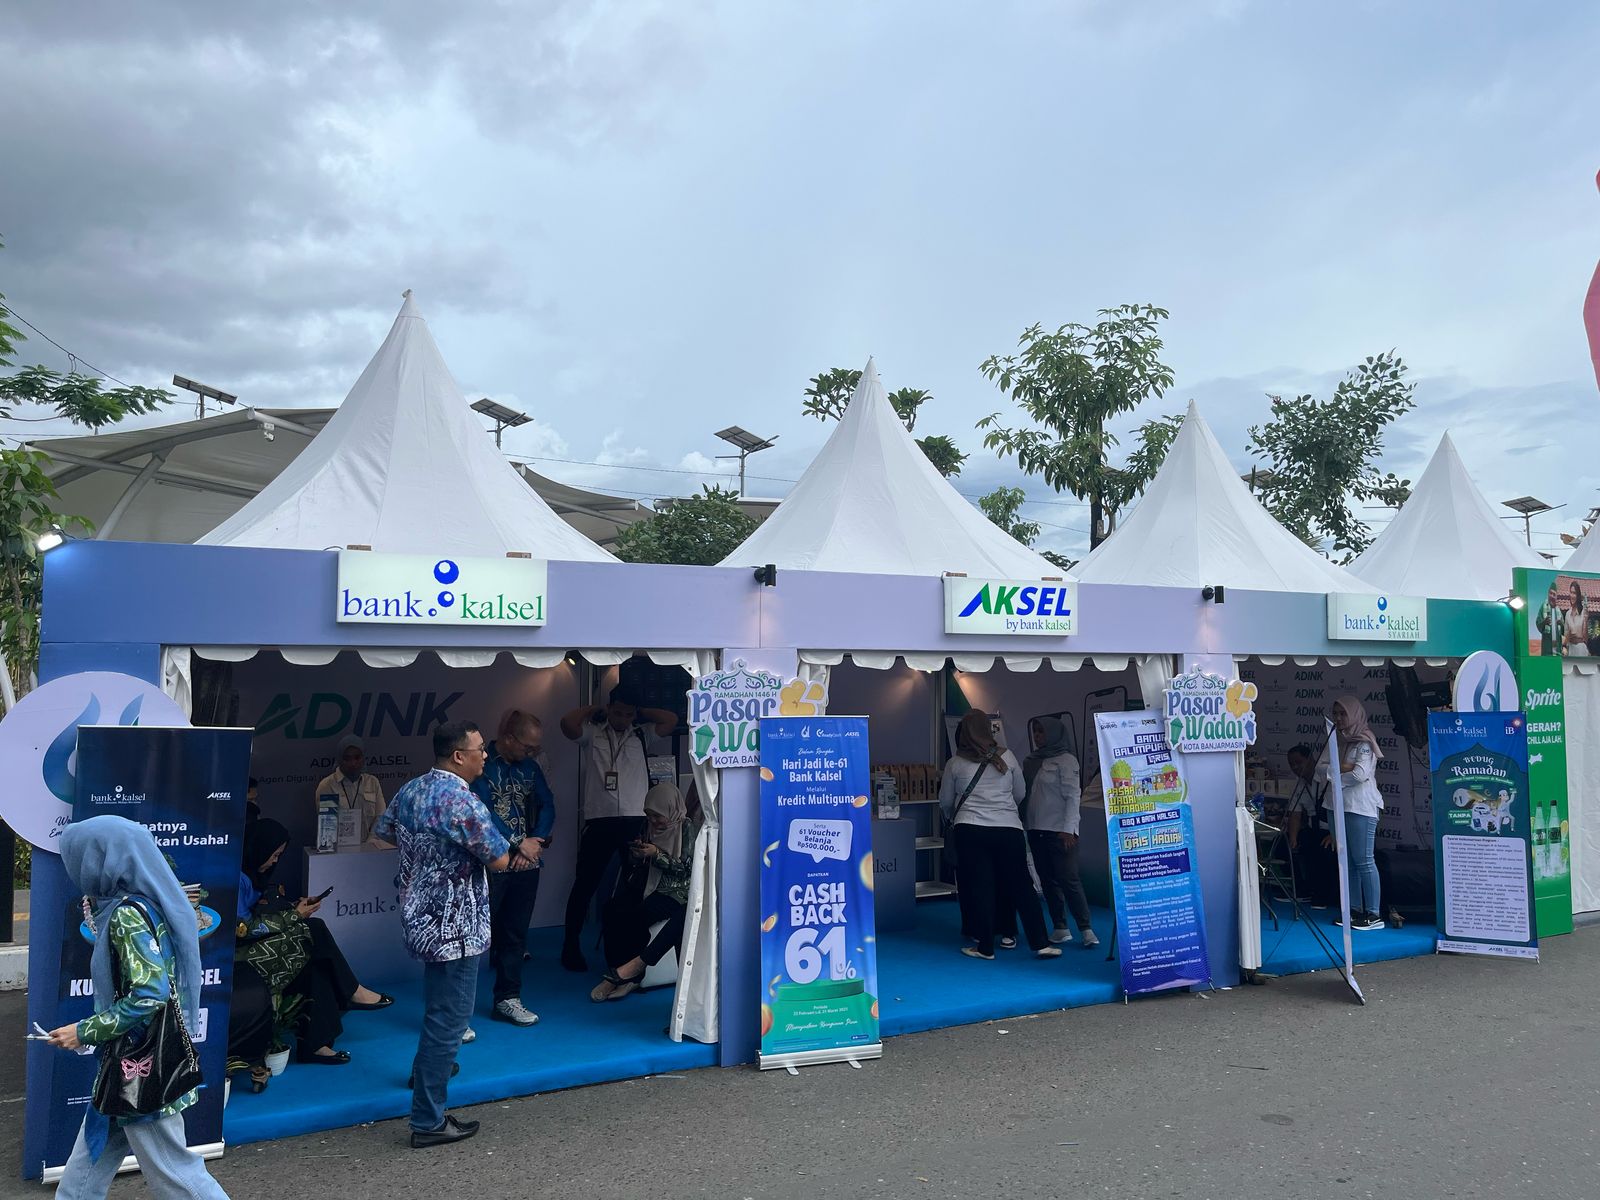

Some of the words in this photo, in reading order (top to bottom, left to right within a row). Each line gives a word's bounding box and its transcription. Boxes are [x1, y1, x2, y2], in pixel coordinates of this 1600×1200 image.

[342, 589, 423, 617] bank
[460, 593, 544, 621] kalsel
[958, 582, 1071, 617] AKSEL
[1006, 618, 1018, 632] by
[1020, 619, 1044, 630] bank
[1045, 619, 1071, 630] kalsel
[1344, 614, 1374, 630] bank
[1387, 615, 1419, 631] kalsel
[1388, 631, 1420, 639] SYARIAH
[1294, 670, 1324, 681] ADINK
[714, 691, 755, 699] RAMADHAN
[1295, 688, 1325, 699] ADINK
[1525, 688, 1561, 710] Sprite
[692, 693, 777, 723] Pasar
[1167, 691, 1224, 716] Pasar
[254, 691, 465, 739] ADINK
[1296, 705, 1325, 716] ADINK
[1184, 712, 1243, 740] Wadai
[1432, 726, 1453, 734] bank
[1463, 726, 1487, 734] kalsel
[1505, 726, 1515, 735] iB
[1526, 722, 1562, 733] GERAH?
[1183, 743, 1199, 751] KOTA
[1200, 741, 1245, 750] BANJARMASIN
[1527, 735, 1541, 744] CHILL
[1542, 735, 1551, 744] AJA
[714, 755, 741, 765] KOTA
[782, 758, 801, 770] Hari
[803, 758, 821, 770] Jadi
[824, 757, 848, 769] ke-61
[789, 771, 813, 783] Bank
[815, 769, 842, 782] Kalsel
[1451, 765, 1507, 778] Ramadan
[91, 793, 113, 802] bank
[122, 792, 146, 802] kalsel
[206, 791, 232, 799] AKSEL
[777, 794, 806, 807] Kredit
[808, 793, 855, 807] Multiguna
[183, 834, 229, 846] Usaha!
[804, 835, 832, 845] Belanja
[808, 829, 841, 838] Voucher
[788, 882, 845, 906] CASH
[336, 896, 386, 917] bank
[790, 903, 848, 926] BACK
